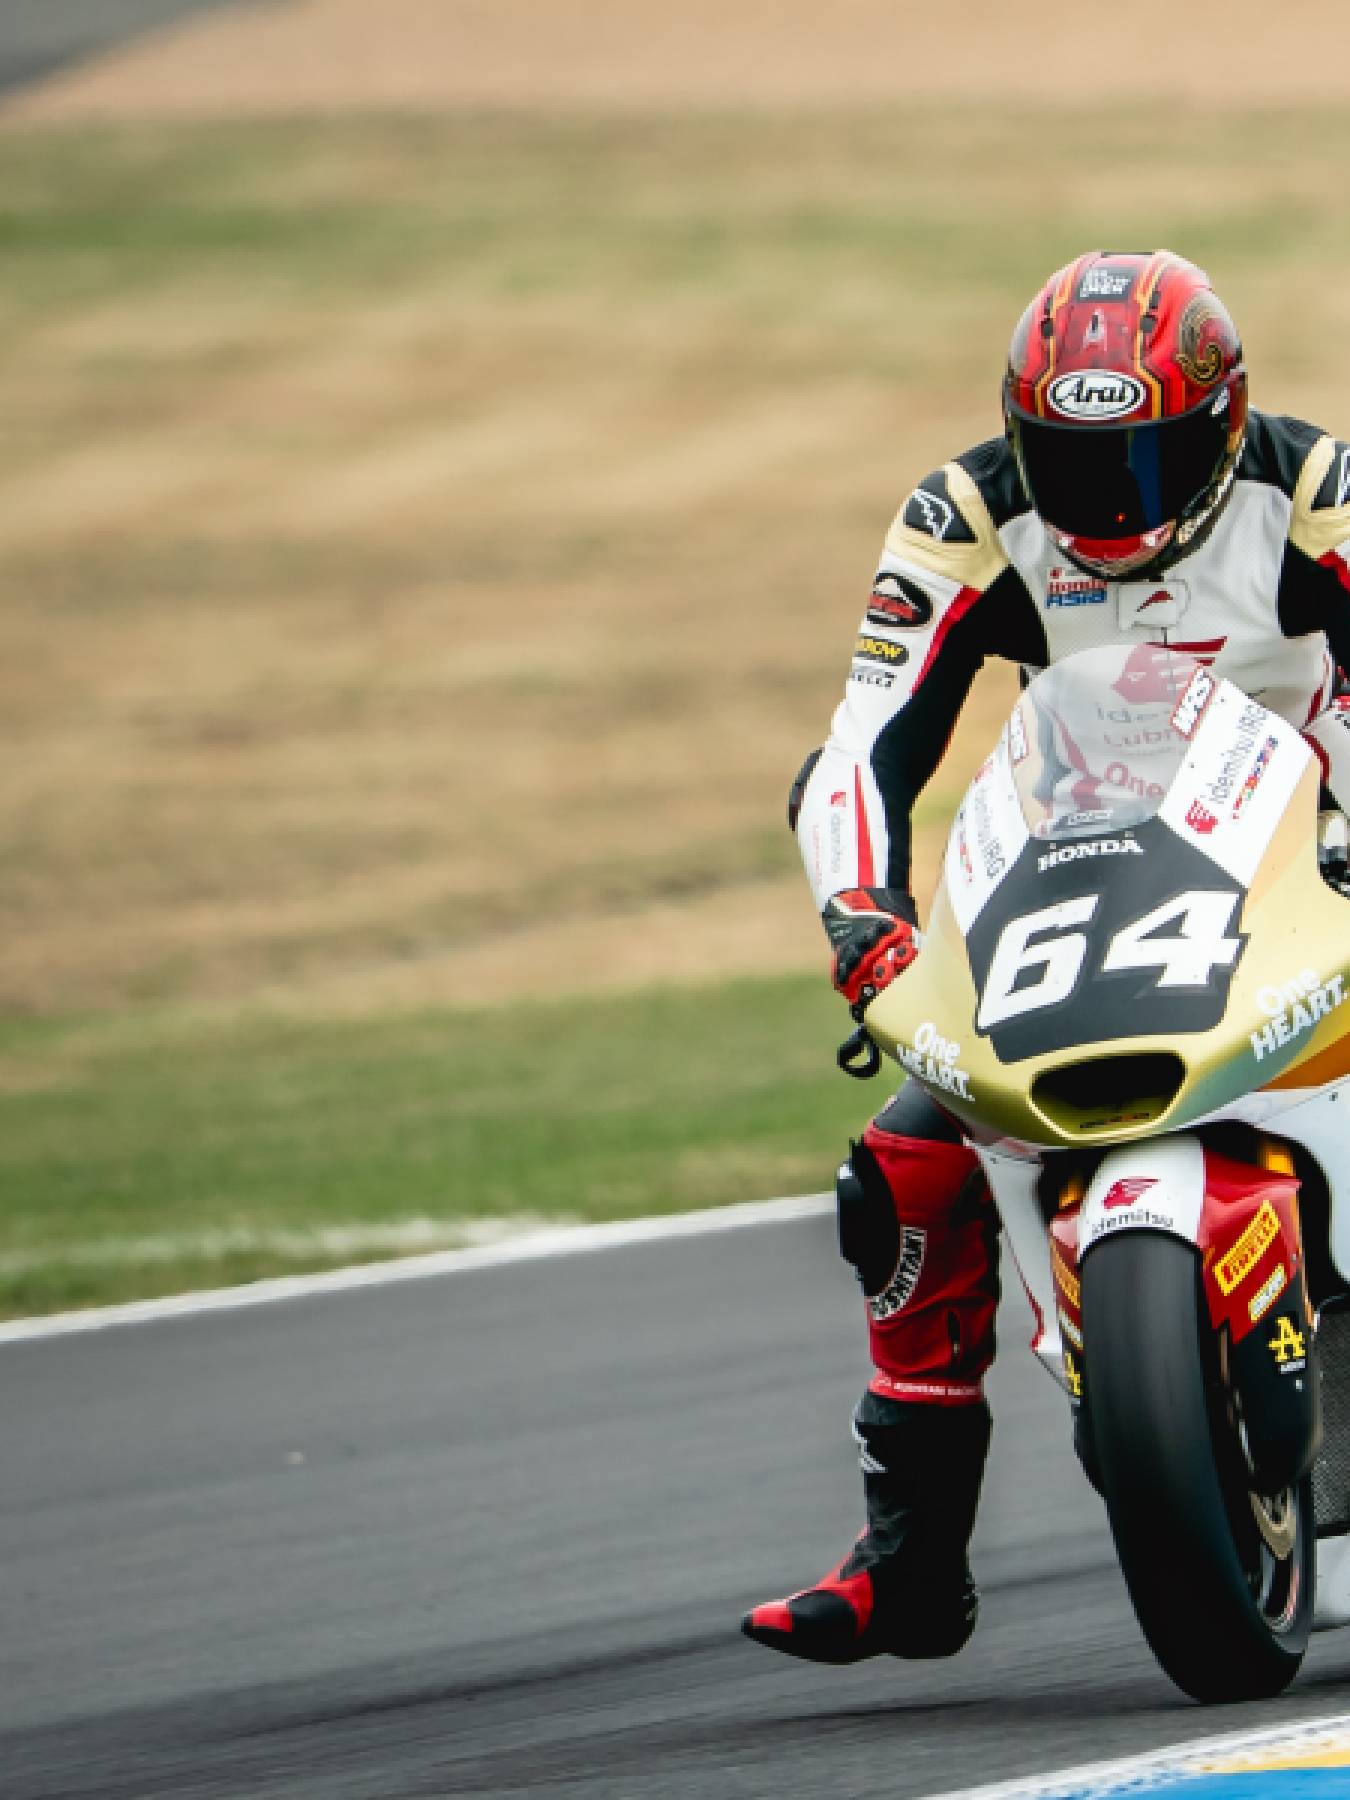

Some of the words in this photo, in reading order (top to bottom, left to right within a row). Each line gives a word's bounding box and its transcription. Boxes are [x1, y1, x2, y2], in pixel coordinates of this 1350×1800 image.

[1057, 376, 1126, 403] Arai
[1037, 836, 1144, 872] HONDA
[976, 890, 1243, 1030] 64
[1257, 968, 1320, 1015] One
[913, 1022, 960, 1065] One
[1093, 1209, 1174, 1235] idemitsu
[1220, 1211, 1277, 1284] PIRELLI
